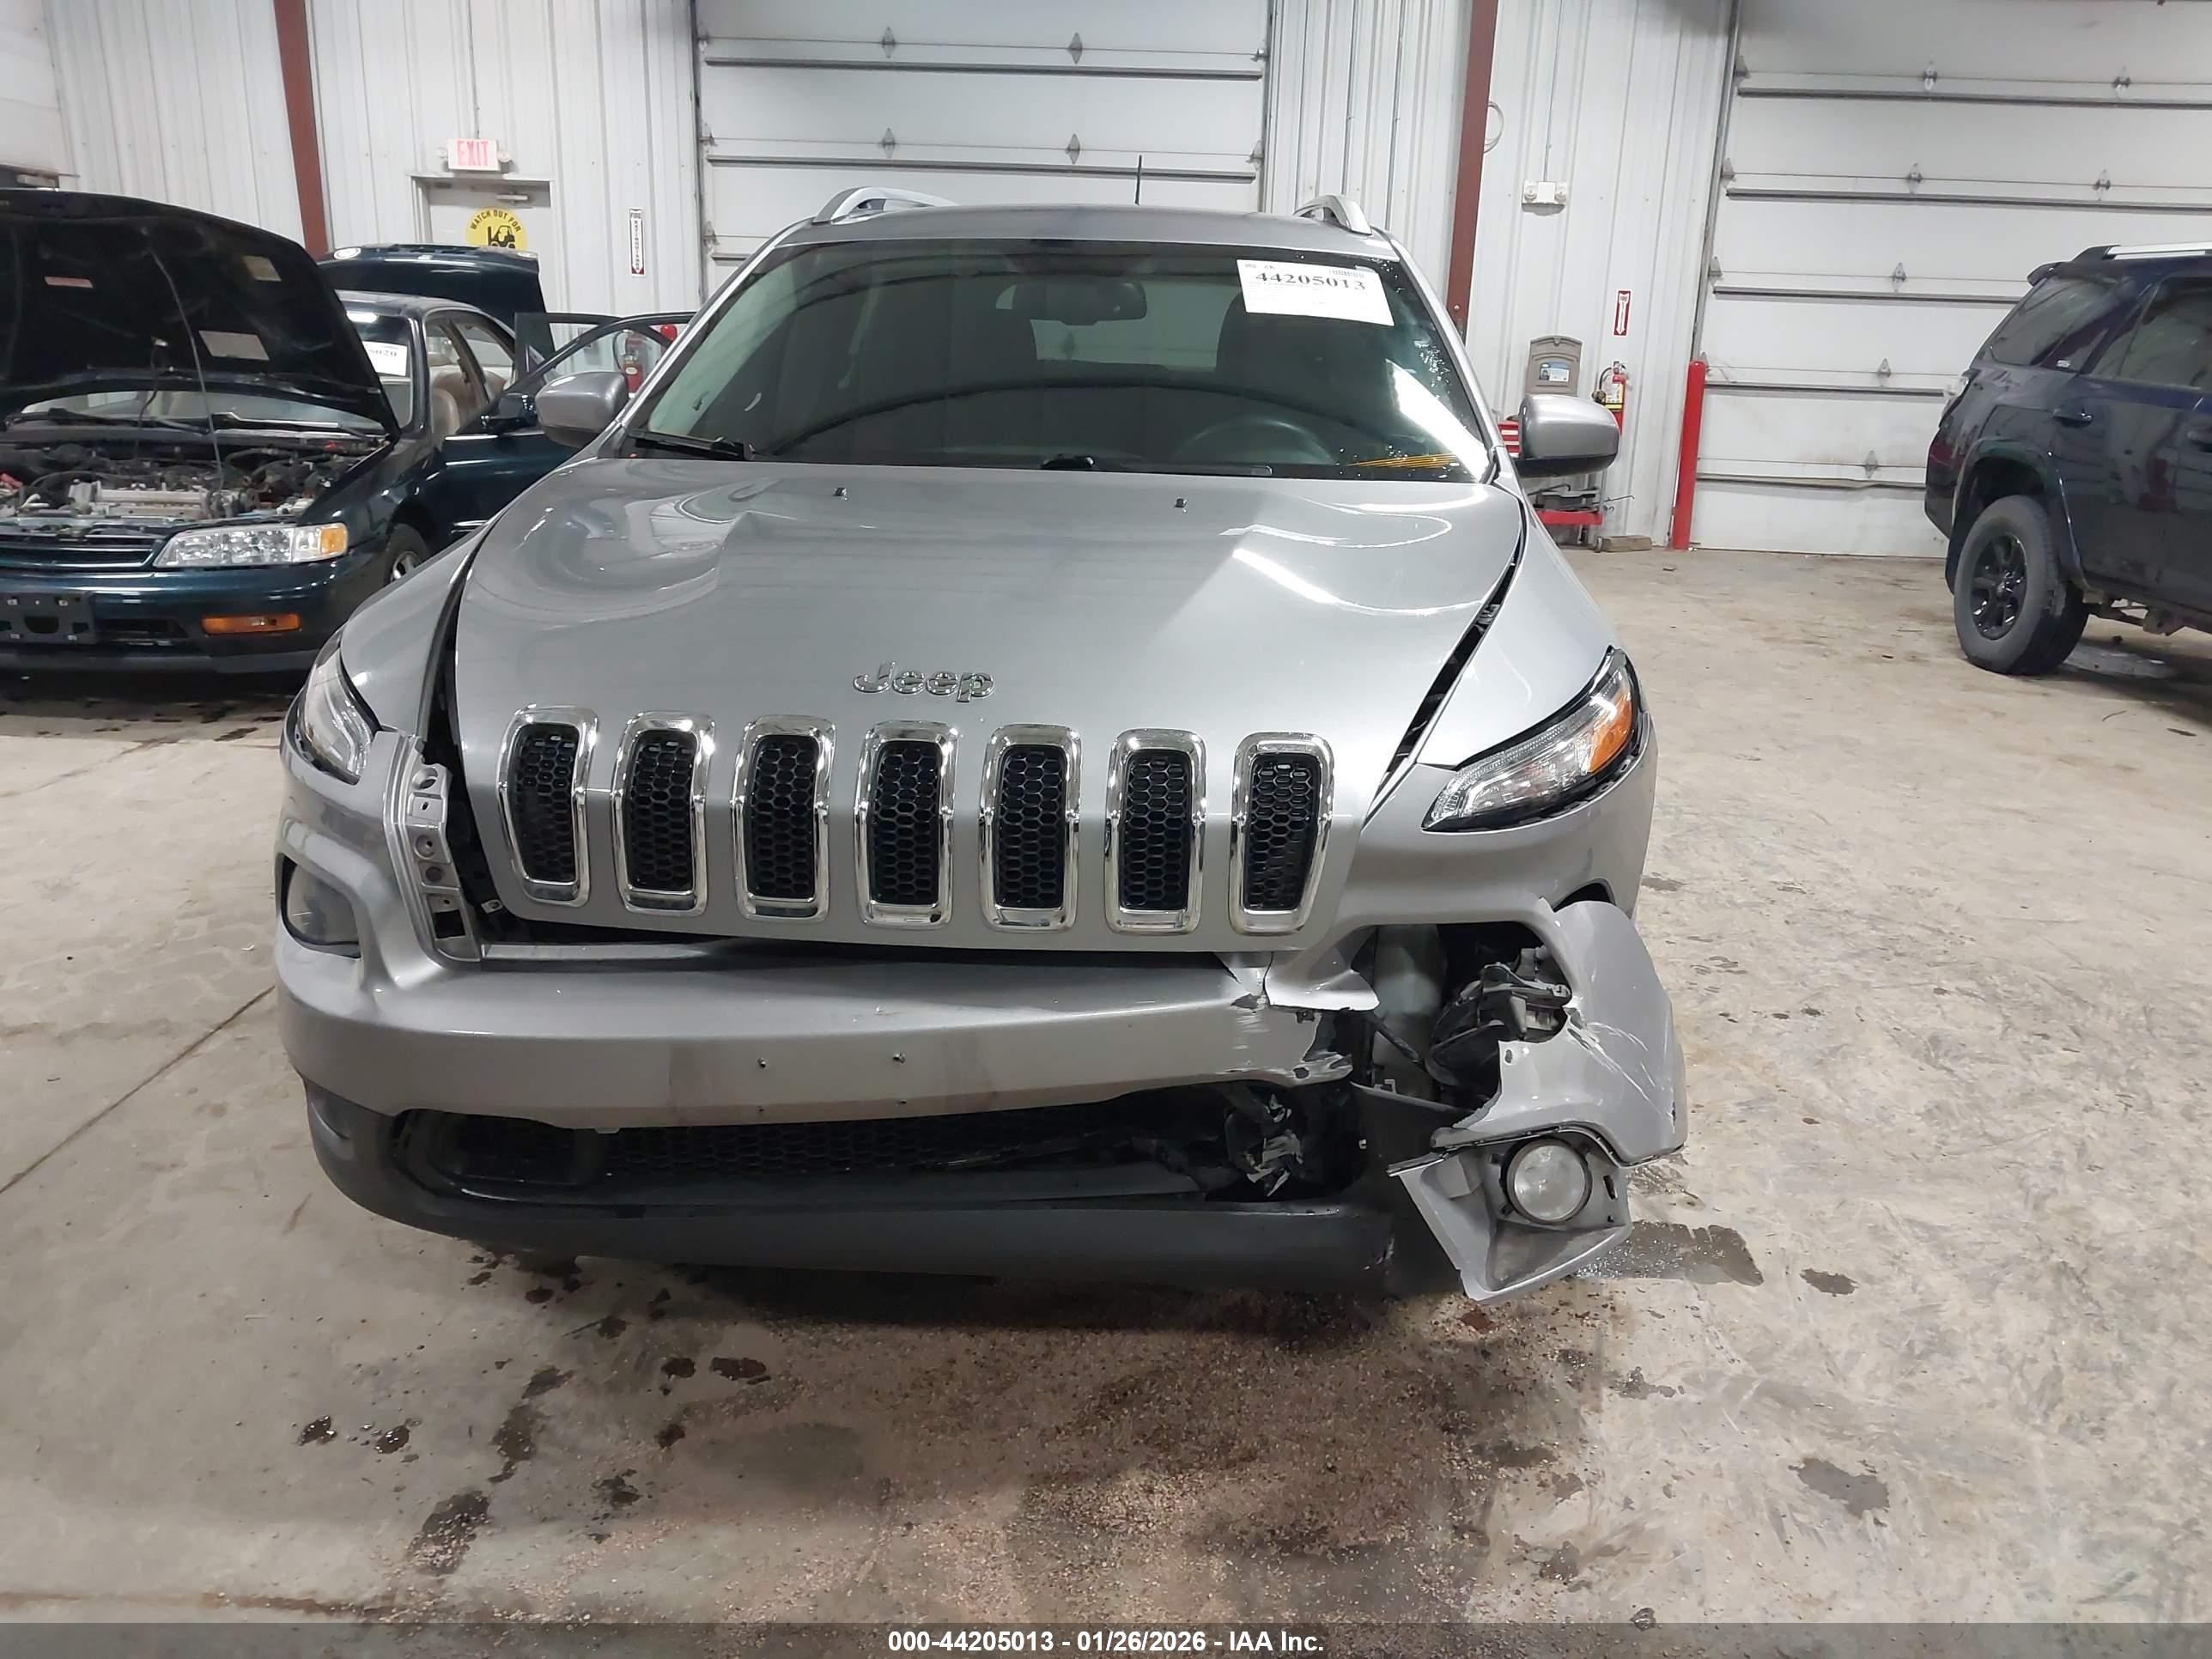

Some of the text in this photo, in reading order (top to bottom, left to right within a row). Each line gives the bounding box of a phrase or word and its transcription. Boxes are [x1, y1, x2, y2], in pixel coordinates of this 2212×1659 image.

[456, 140, 489, 167] EXIT
[470, 209, 521, 232] WATCH OUT FOR
[1255, 271, 1366, 290] 44205013
[853, 660, 995, 702] Jeep
